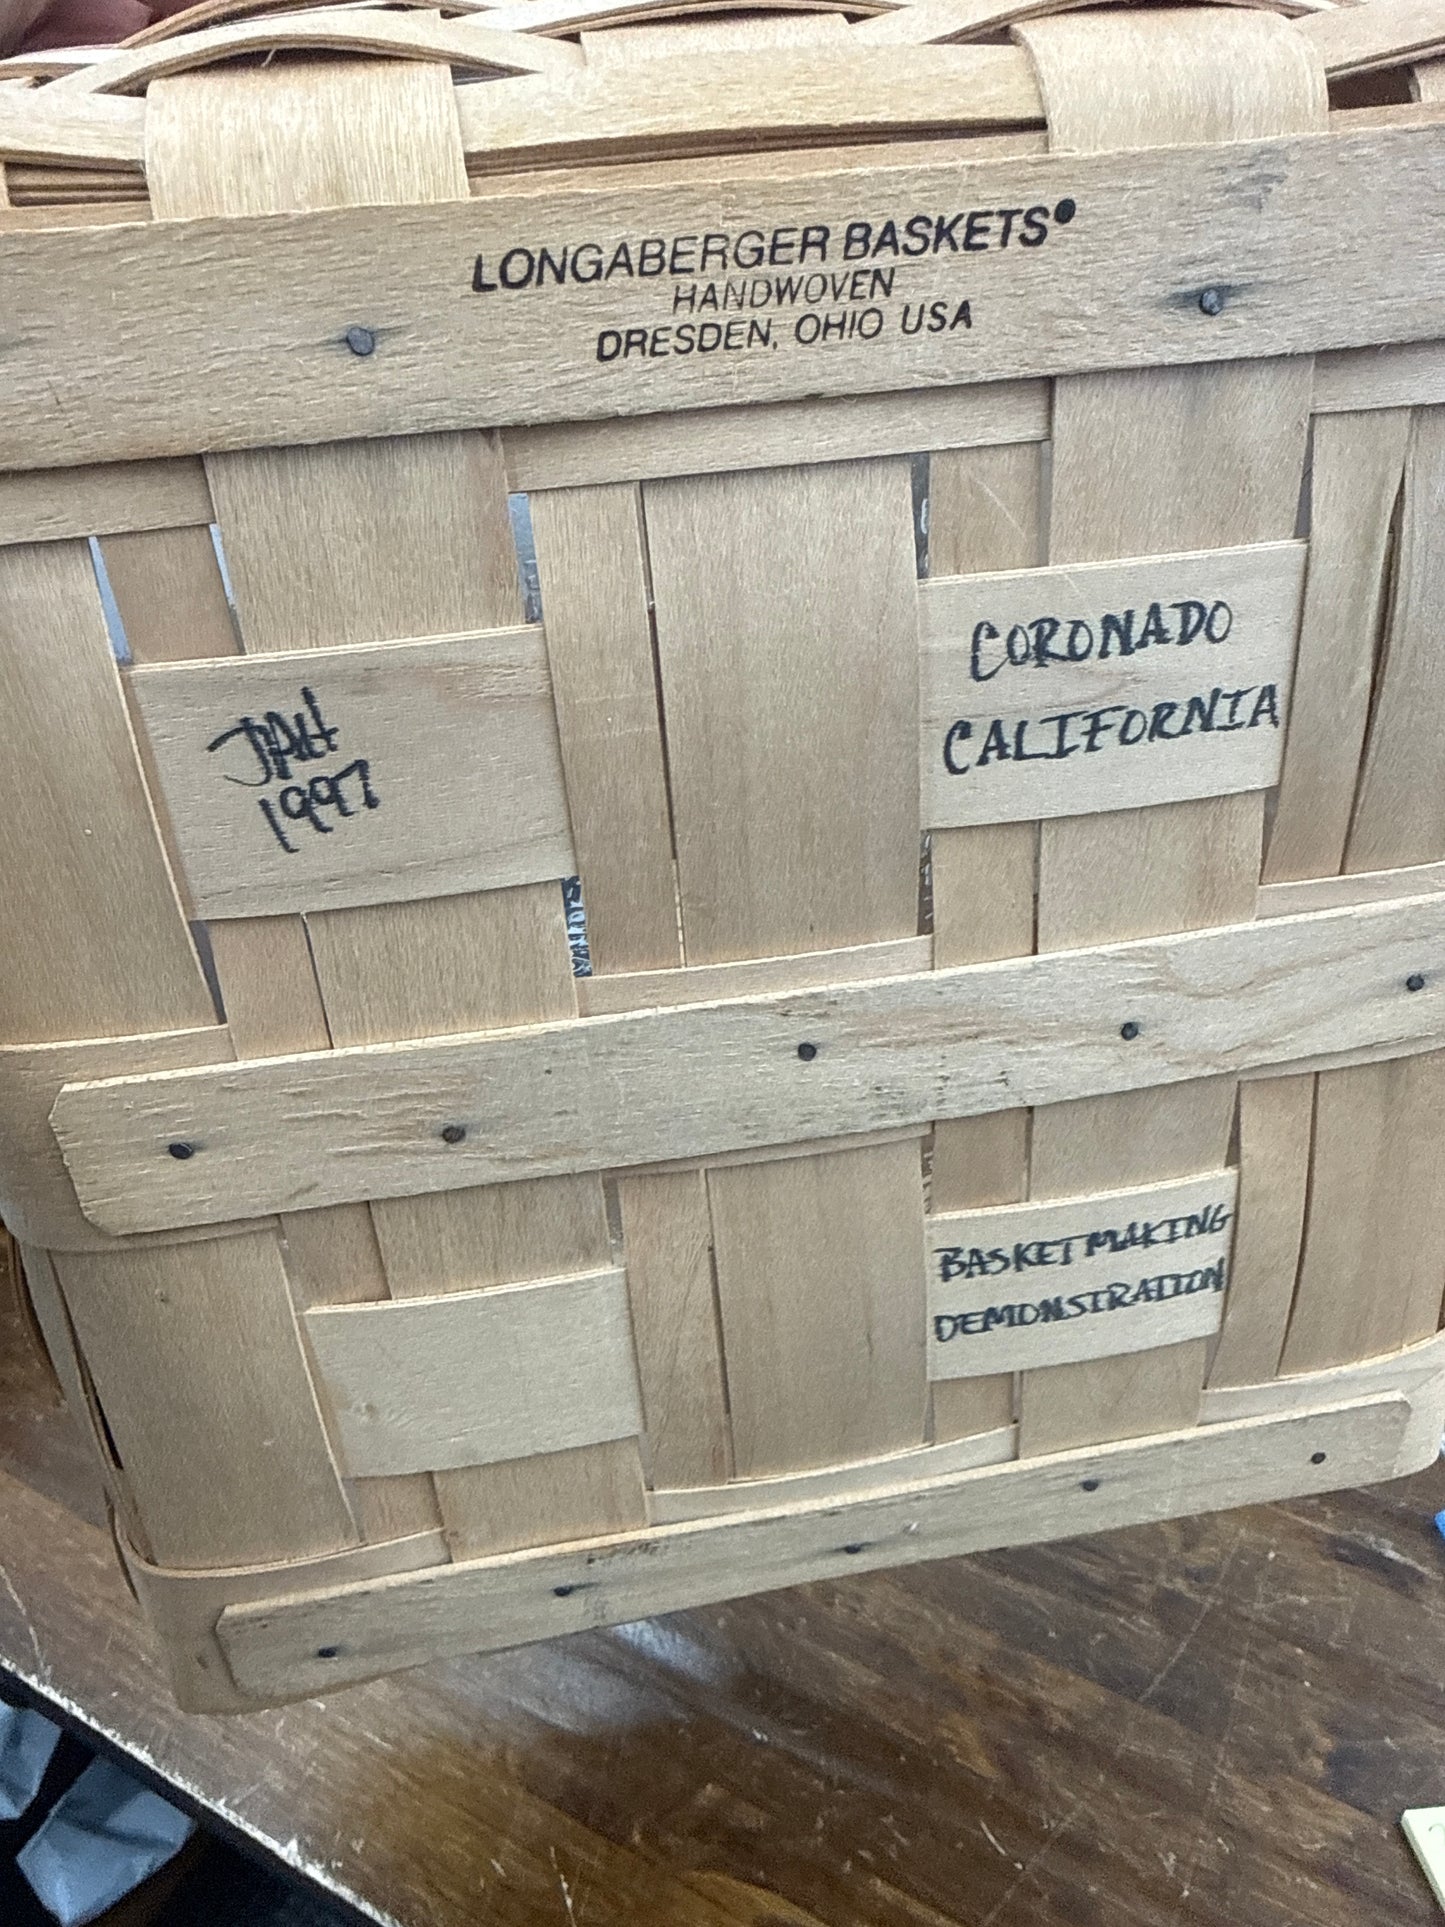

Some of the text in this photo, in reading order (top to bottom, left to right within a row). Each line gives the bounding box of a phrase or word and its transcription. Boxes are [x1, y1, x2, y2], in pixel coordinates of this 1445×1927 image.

[472, 225, 830, 292] LONGABERGER
[673, 267, 895, 313] HANDWOVEN
[596, 300, 973, 362] DRESDEN, OHIO USA
[970, 600, 1233, 682] CORONADO
[943, 683, 1279, 775] CALIFORNIA
[258, 759, 380, 854] 1997
[934, 1257, 1225, 1343] DEMONSTRATION
